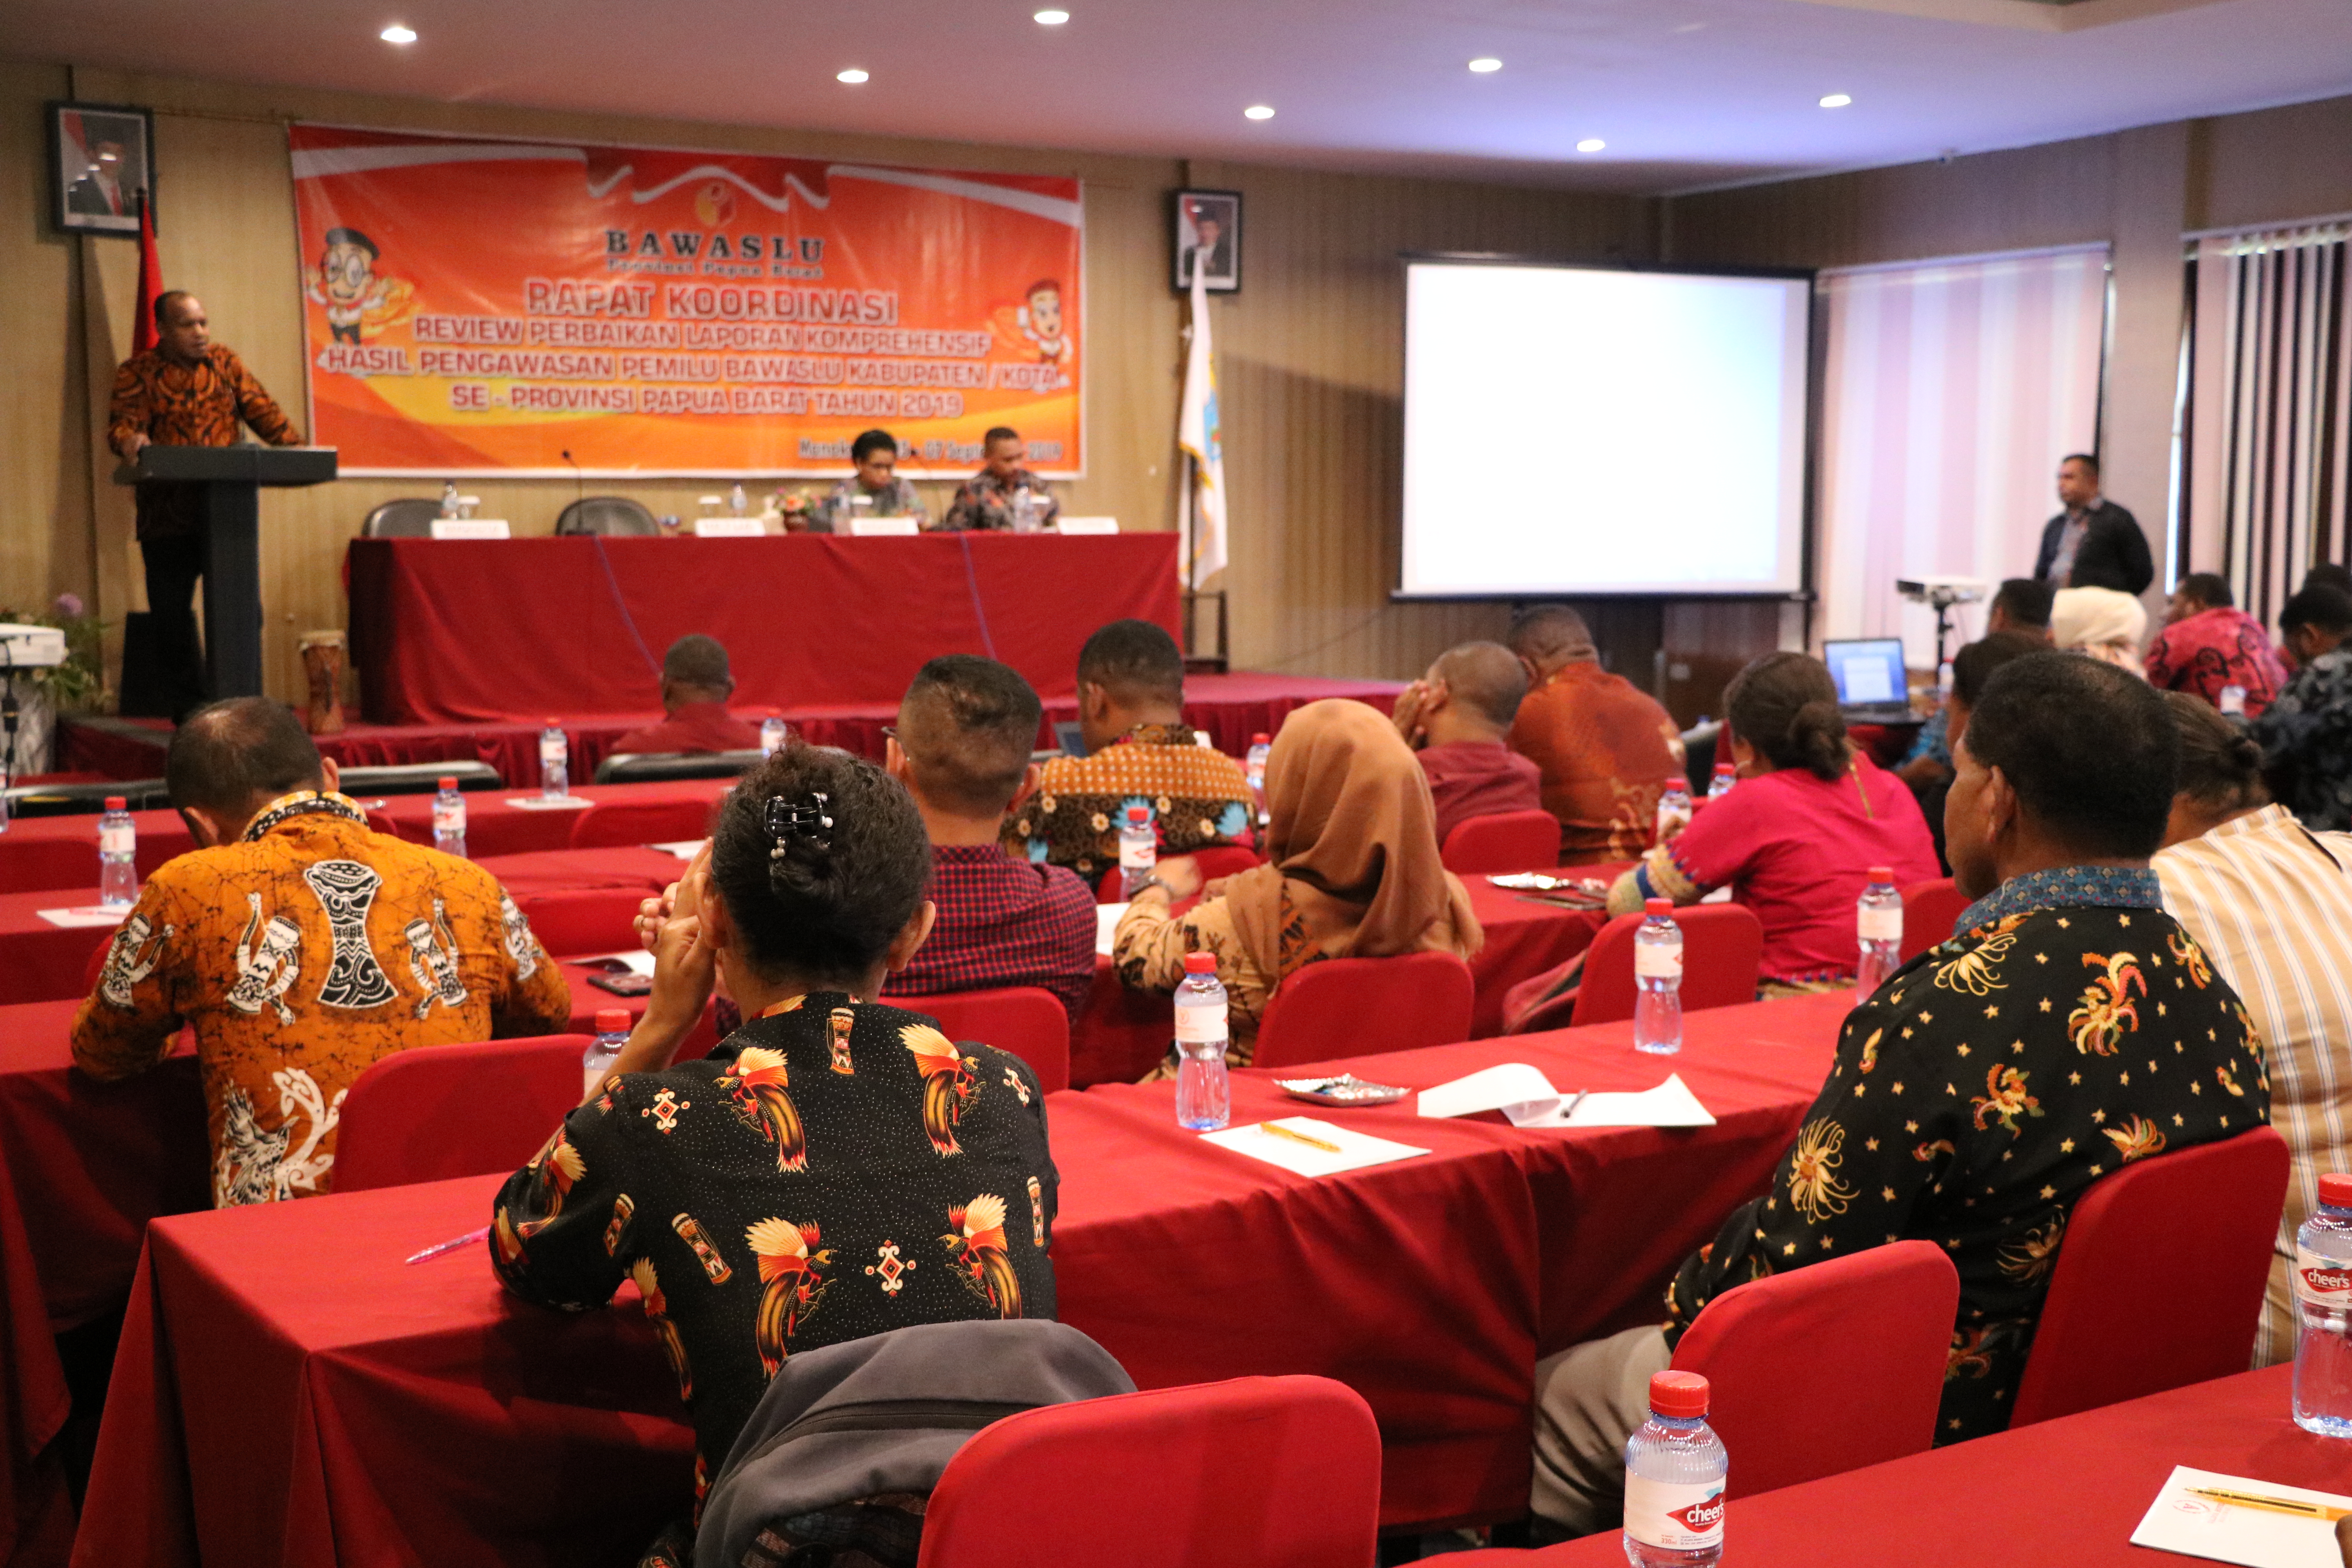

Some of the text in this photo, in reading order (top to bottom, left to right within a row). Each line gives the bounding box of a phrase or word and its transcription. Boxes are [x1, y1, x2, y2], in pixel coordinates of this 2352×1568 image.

[606, 230, 824, 262] BAWASLU
[608, 259, 822, 278] Provinsi Papua Barat
[527, 279, 897, 325] RAPAT KOORDINASI
[415, 316, 991, 357] REVIEW PERBAIKAN LAPORAN KOMPREHENSIF
[327, 346, 412, 375] HASIL
[419, 350, 614, 379] PENGAWASAN
[619, 355, 720, 382] PEMILU
[725, 357, 843, 383] BAWASLU
[847, 359, 985, 387] KABUPATEN
[452, 384, 489, 410] SE
[509, 385, 635, 412] PROVINSI
[641, 387, 728, 414] PAPUA
[733, 388, 808, 414] BARAT
[815, 390, 898, 416] TAHUN
[901, 392, 963, 417] 2019
